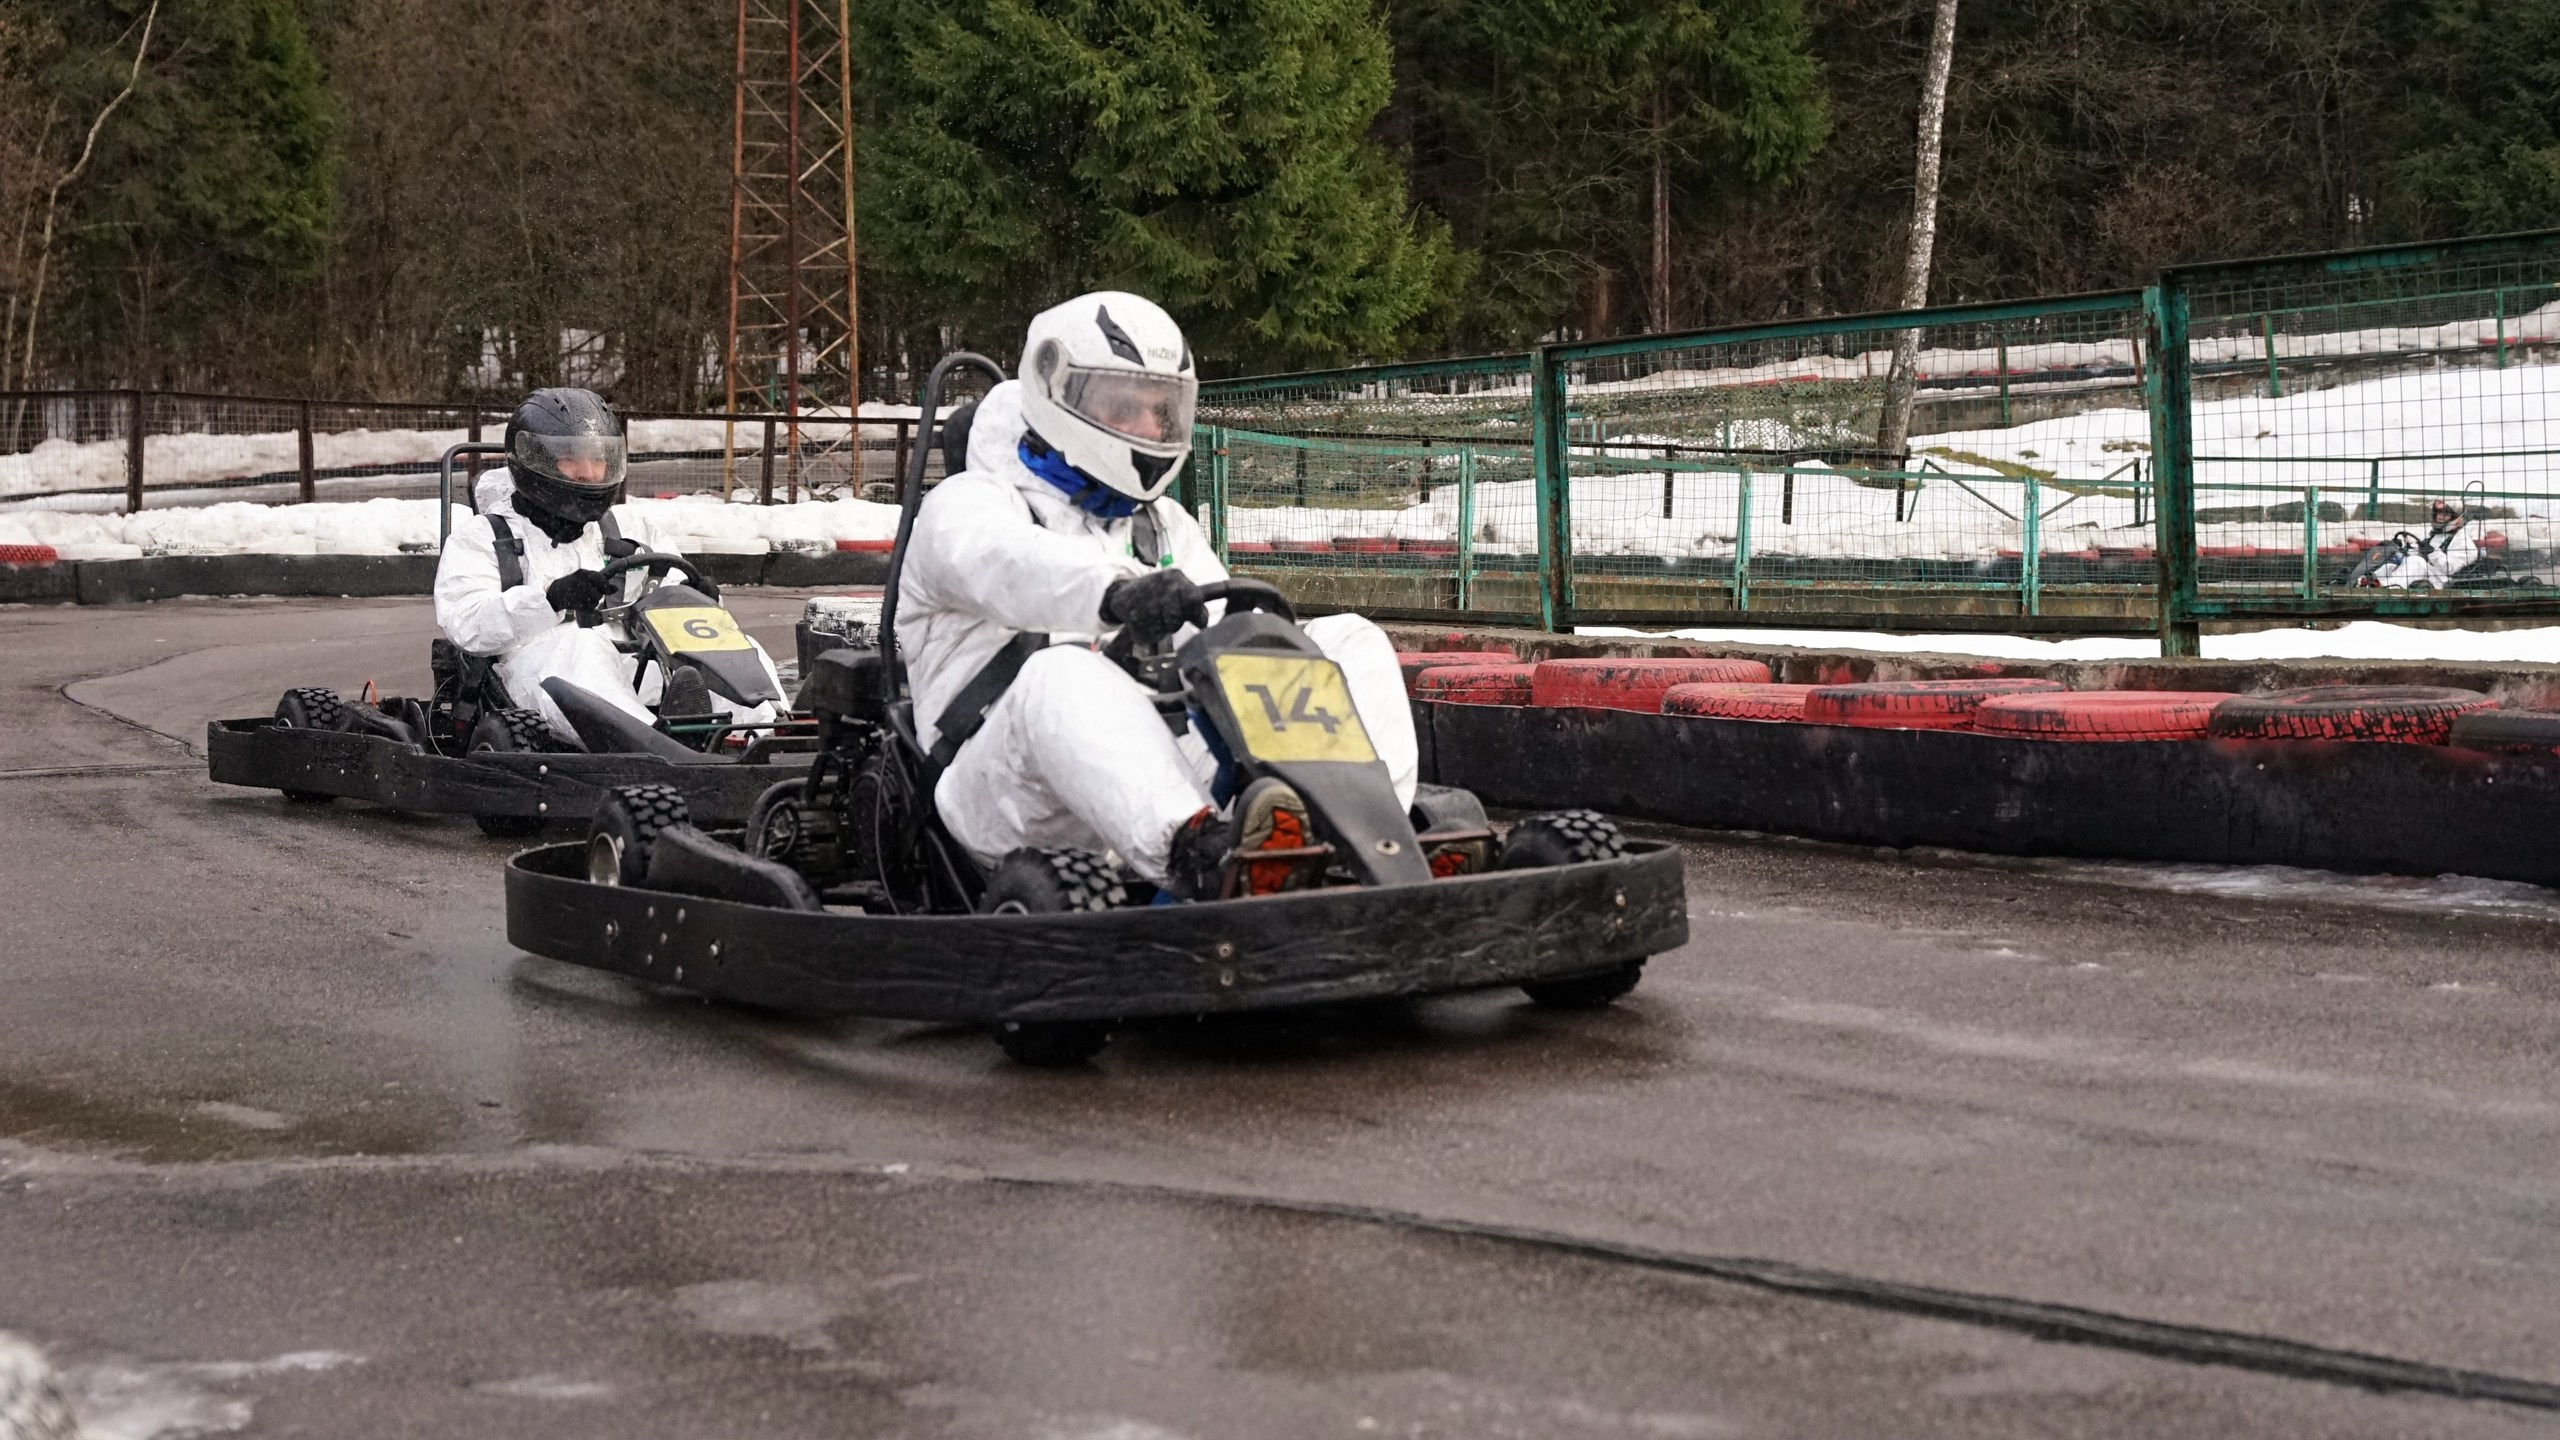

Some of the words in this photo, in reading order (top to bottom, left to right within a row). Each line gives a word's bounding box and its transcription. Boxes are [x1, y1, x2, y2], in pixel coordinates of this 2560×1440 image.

[1147, 346, 1177, 361] HIZER
[683, 619, 719, 639] 6
[1244, 684, 1341, 733] 14
